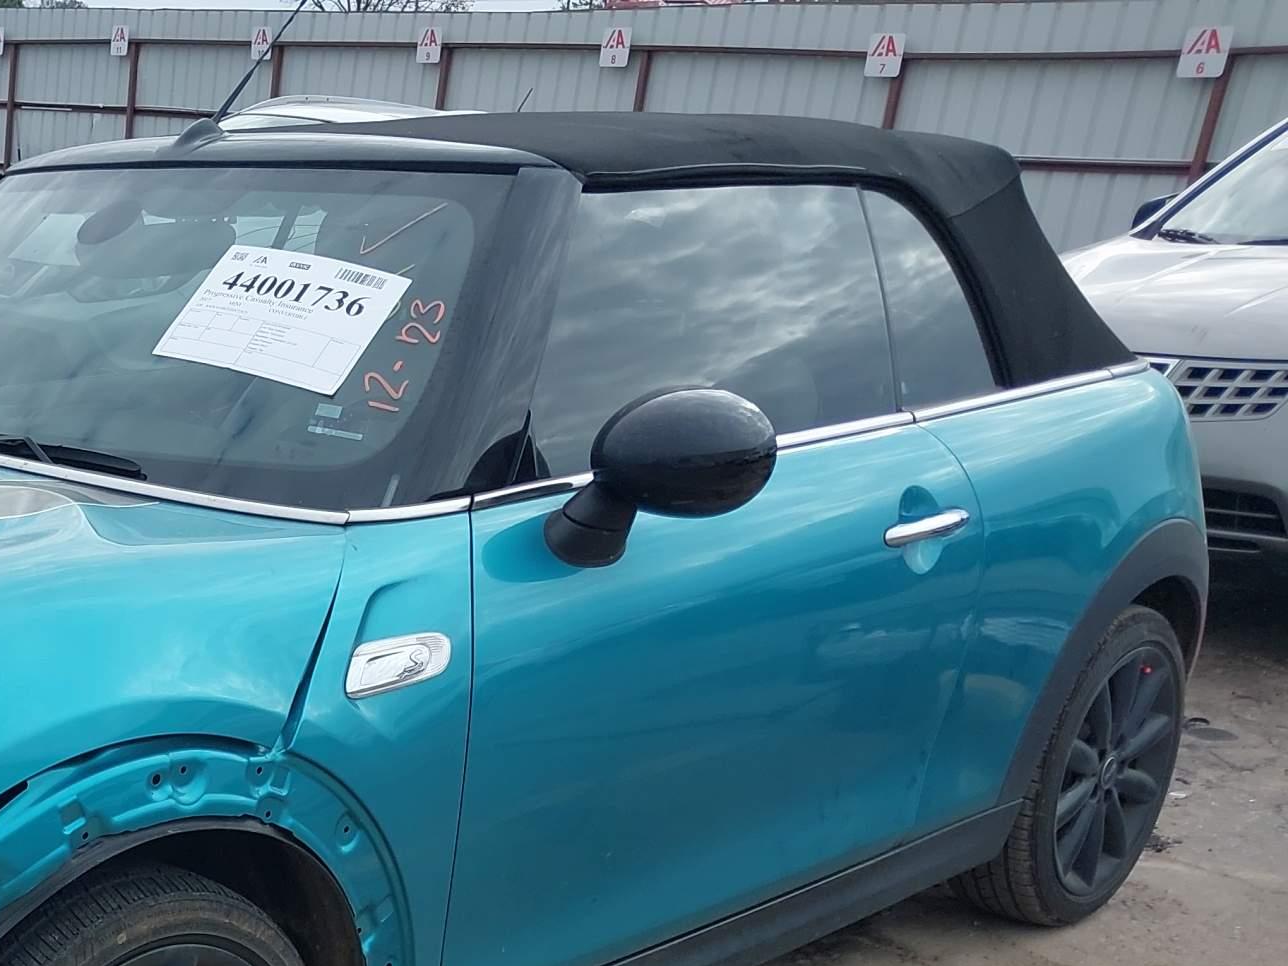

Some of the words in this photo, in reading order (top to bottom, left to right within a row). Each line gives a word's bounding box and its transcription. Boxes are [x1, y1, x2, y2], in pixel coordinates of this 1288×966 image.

[425, 52, 431, 61] 9
[610, 54, 617, 65] 8
[879, 63, 887, 74] 7
[1196, 62, 1205, 74] 6
[221, 270, 372, 317] 44001736
